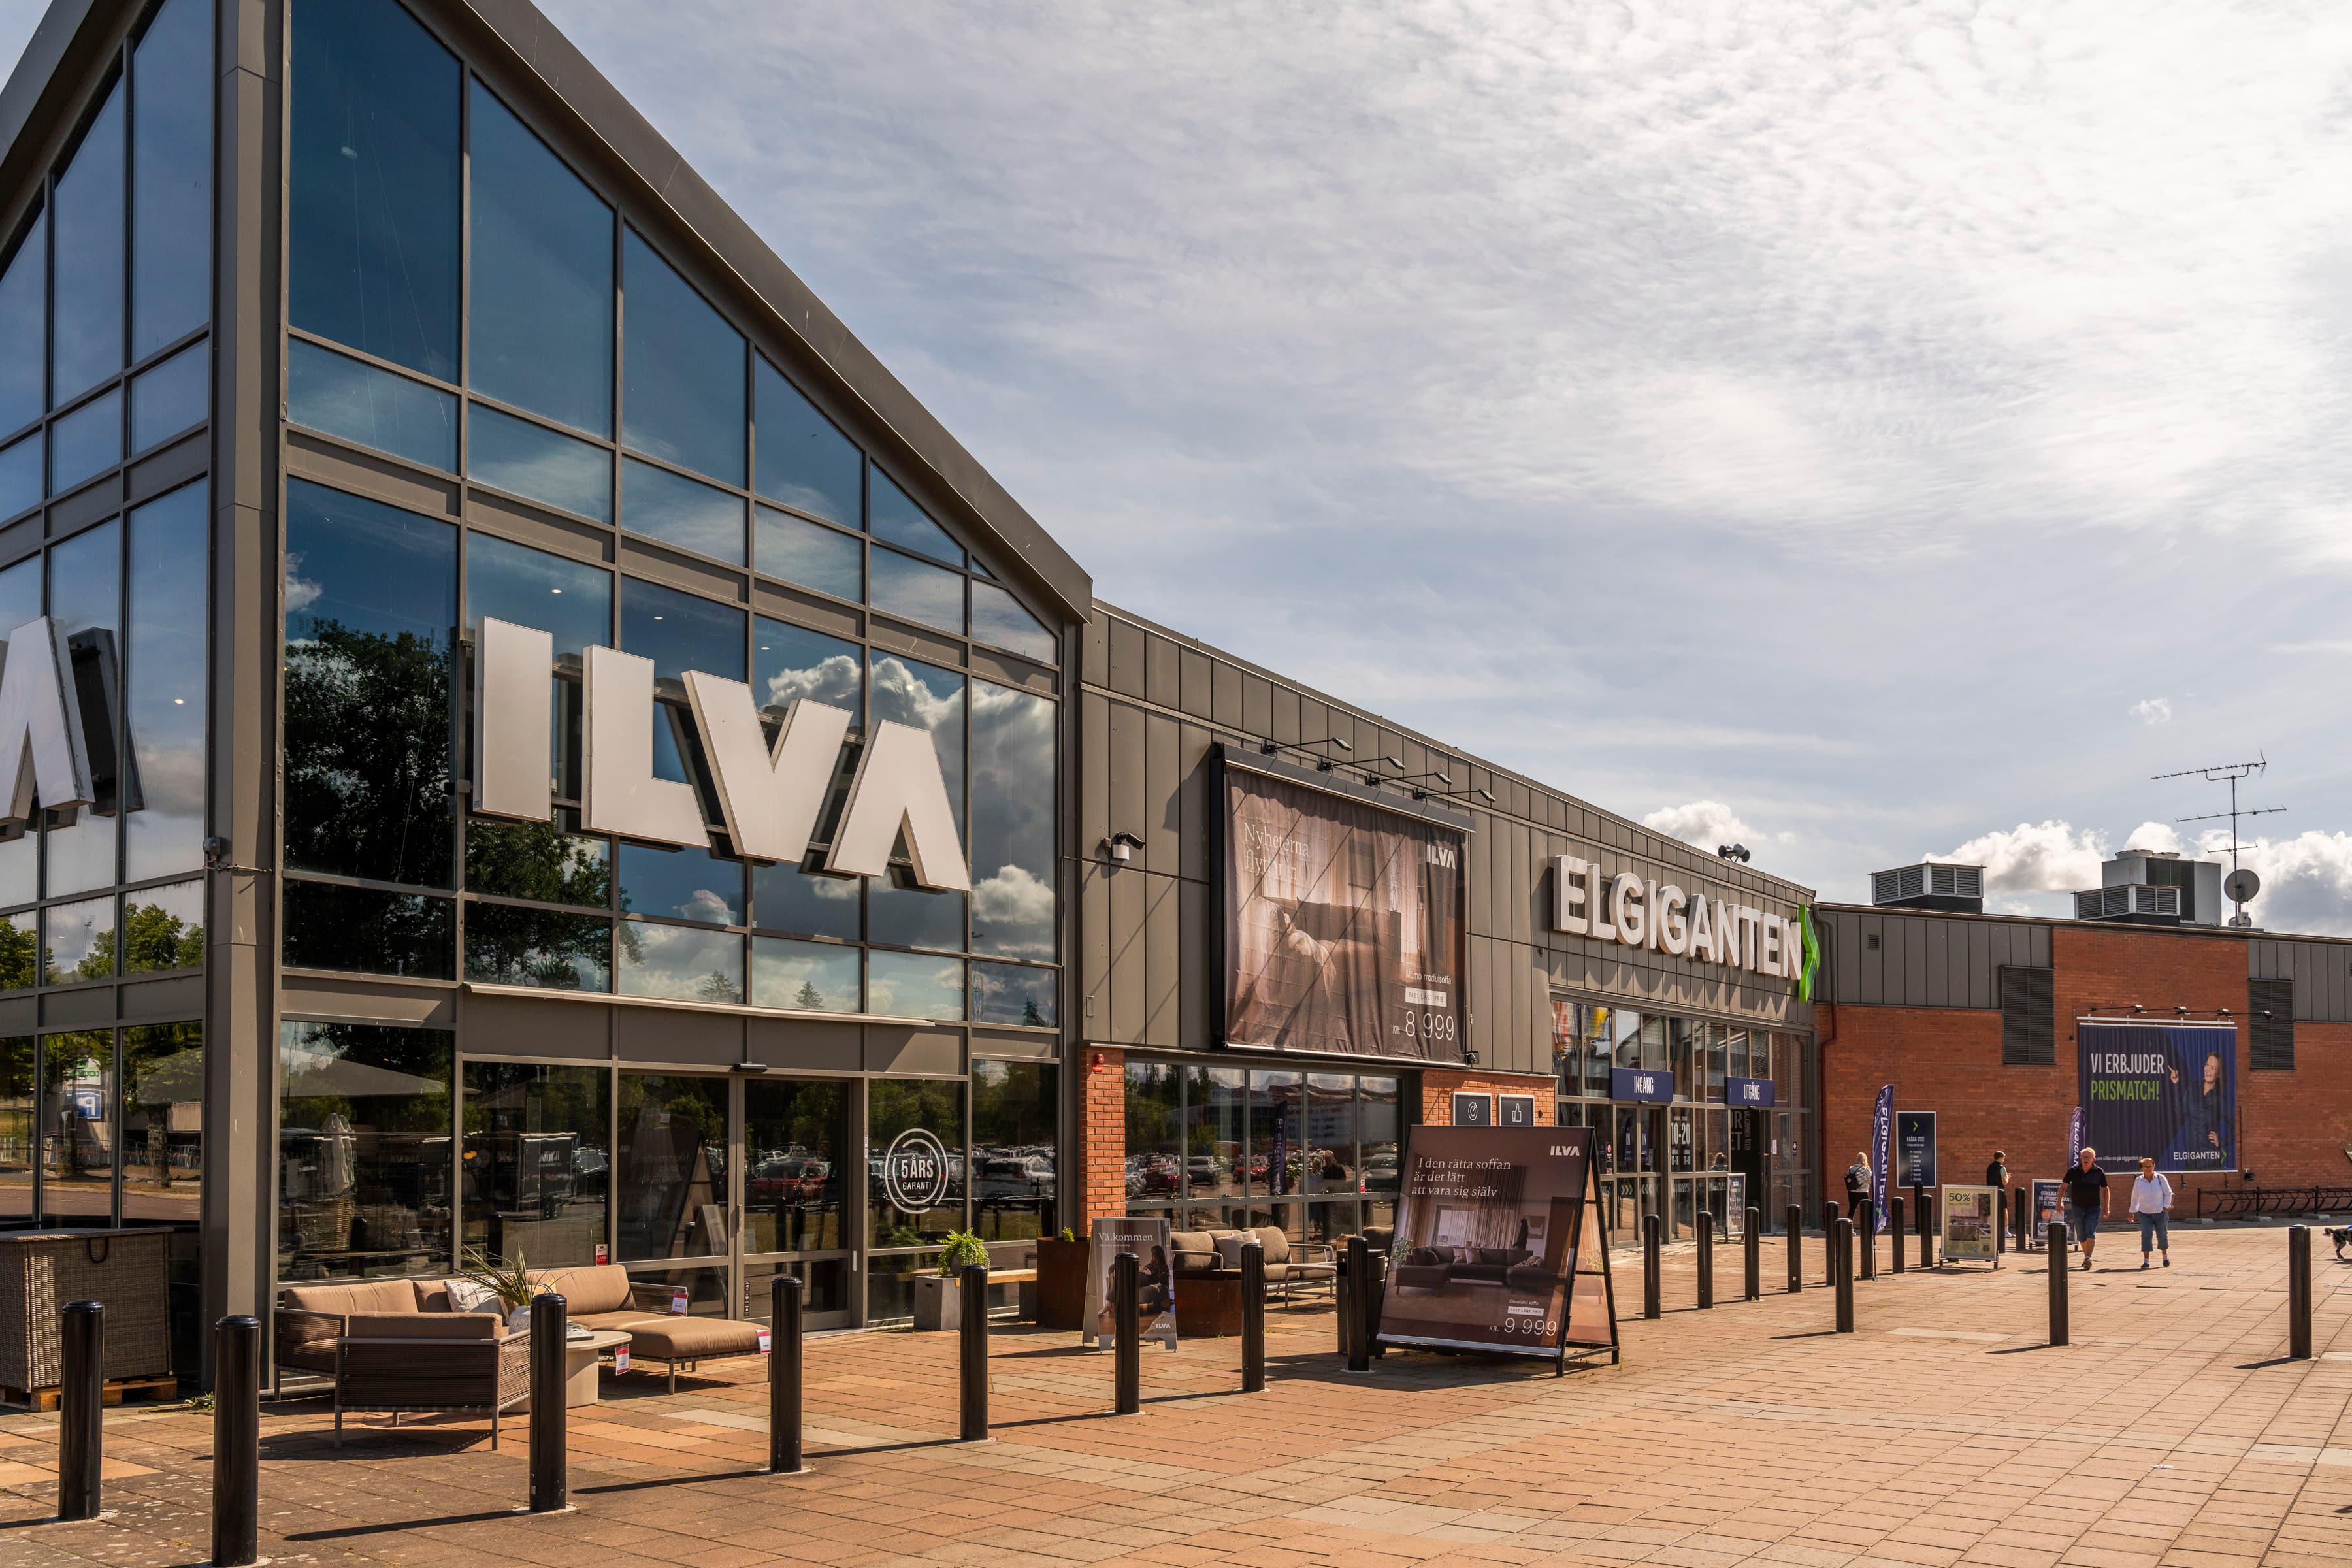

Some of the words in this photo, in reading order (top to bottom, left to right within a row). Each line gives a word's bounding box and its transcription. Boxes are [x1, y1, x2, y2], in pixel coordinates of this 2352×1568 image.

[474, 616, 972, 892] ILVA
[1244, 822, 1309, 857] Nyheterna
[1426, 844, 1456, 870] ILVA
[1553, 854, 1801, 980] ELGIGANTEN
[1405, 970, 1422, 980] Momo
[1424, 973, 1452, 985] modulsoffa
[1405, 1011, 1415, 1037] 8
[1423, 1013, 1454, 1041] 999
[2091, 1053, 2102, 1073] VI
[2106, 1053, 2164, 1074] ERBJUDER
[1634, 1073, 1654, 1094] INGÅNG
[1743, 1082, 1760, 1100] UTGÅNG
[2091, 1080, 2159, 1100] PRISMATCH!
[1671, 1122, 1690, 1145] 10-20
[1550, 1145, 1580, 1156] ILVA
[2173, 1151, 2221, 1160] ELGIGANTEN
[1418, 1157, 1424, 1168] I
[1425, 1158, 1445, 1168] den
[1448, 1159, 1473, 1169] rätta
[1476, 1158, 1511, 1169] soffan
[902, 1181, 932, 1190] GARANTI
[1414, 1171, 1425, 1181] är
[1427, 1171, 1445, 1182] det
[1446, 1171, 1465, 1182] lätt
[1411, 1186, 1426, 1195] att
[1428, 1186, 1450, 1196] vara
[1454, 1186, 1469, 1198] sig
[1471, 1185, 1498, 1198] själv
[1949, 1192, 1970, 1201] 50%
[1098, 1232, 1154, 1241] Välkommen
[1504, 1317, 1515, 1333] 9
[1522, 1319, 1556, 1336] 999
